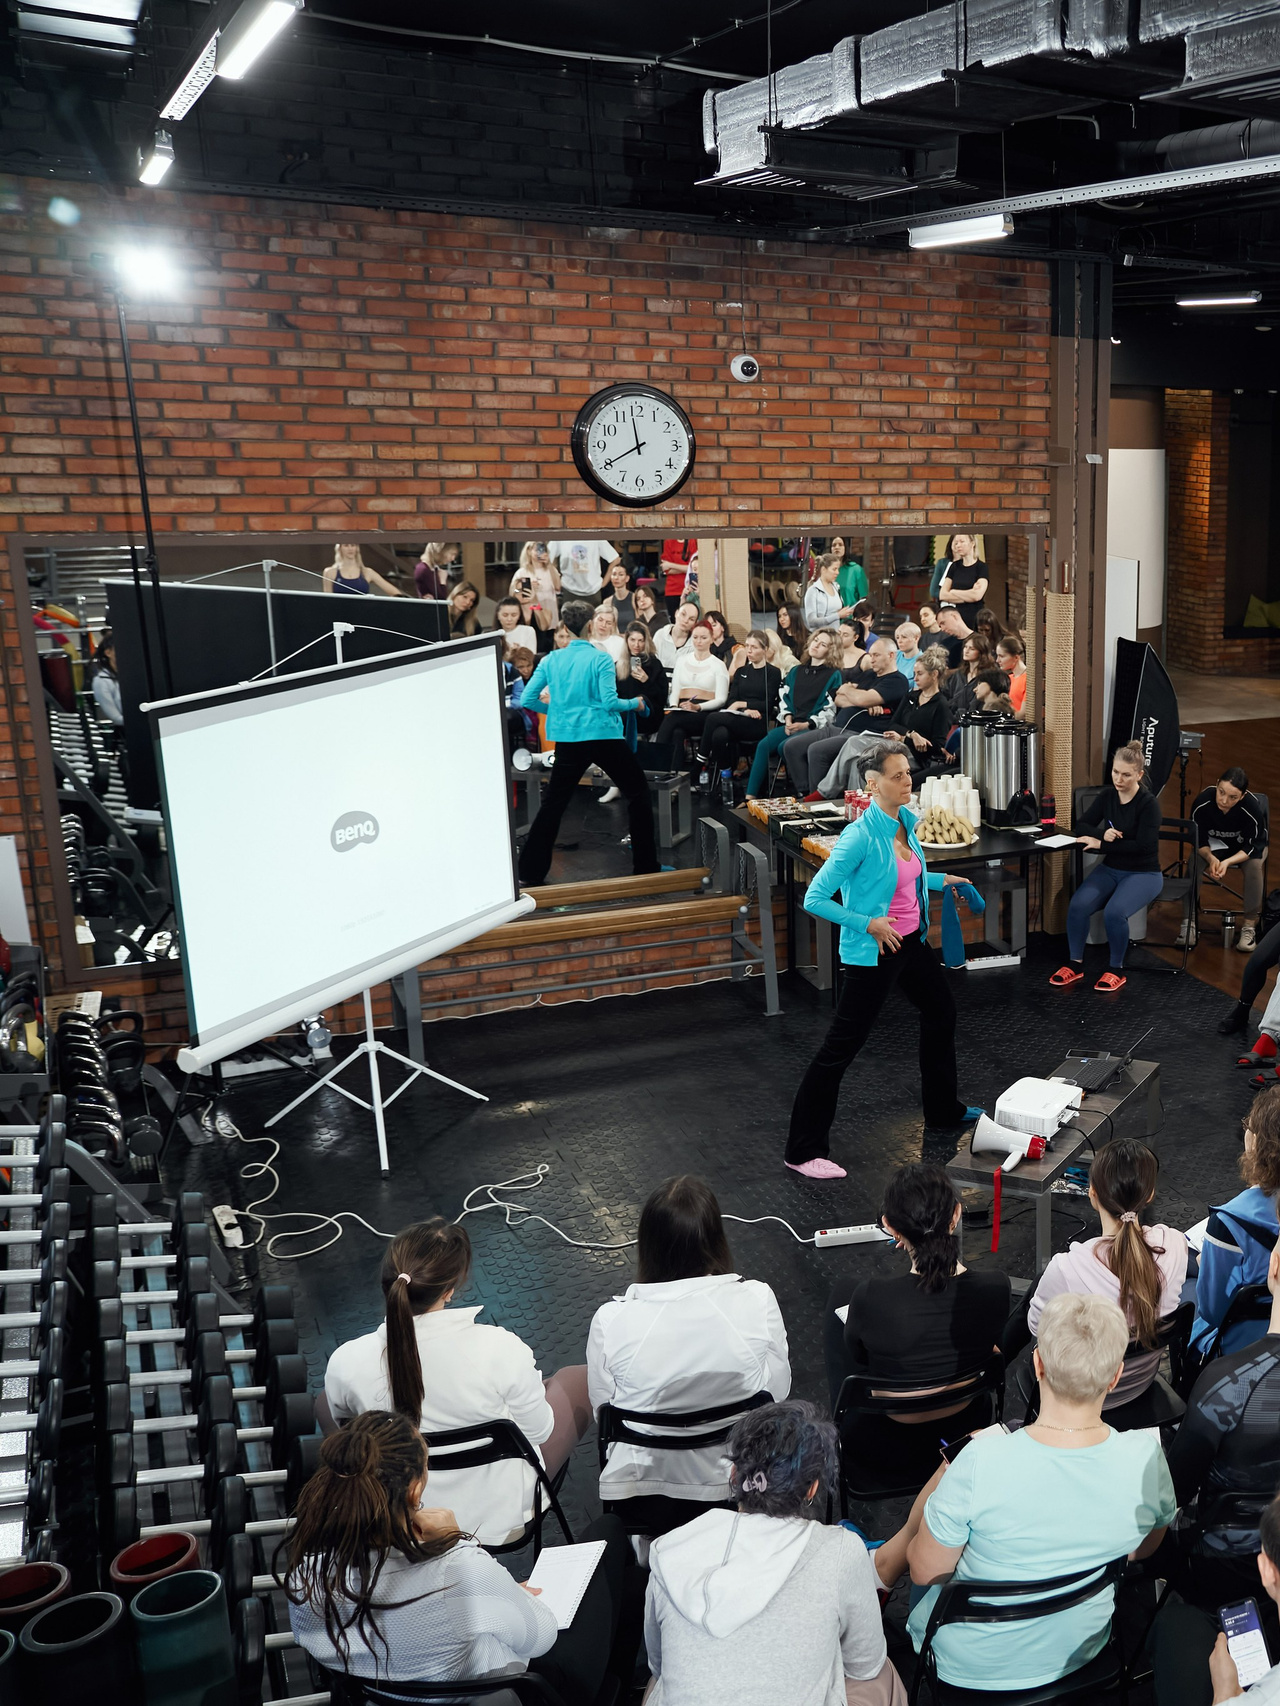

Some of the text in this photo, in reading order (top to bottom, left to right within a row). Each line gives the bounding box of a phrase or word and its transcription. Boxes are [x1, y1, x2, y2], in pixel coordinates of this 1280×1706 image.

[615, 410, 627, 423] 11
[630, 405, 644, 418] 12
[652, 410, 656, 422] 1
[603, 424, 617, 437] 10
[663, 421, 671, 434] 2
[596, 439, 607, 453] 9
[671, 439, 679, 452] 3
[603, 458, 613, 471] 8
[665, 457, 674, 469] 4
[619, 470, 627, 482] 7
[635, 474, 645, 488] 6
[654, 470, 663, 483] 5
[1144, 716, 1159, 766] Aputure
[335, 820, 376, 845] BenQ
